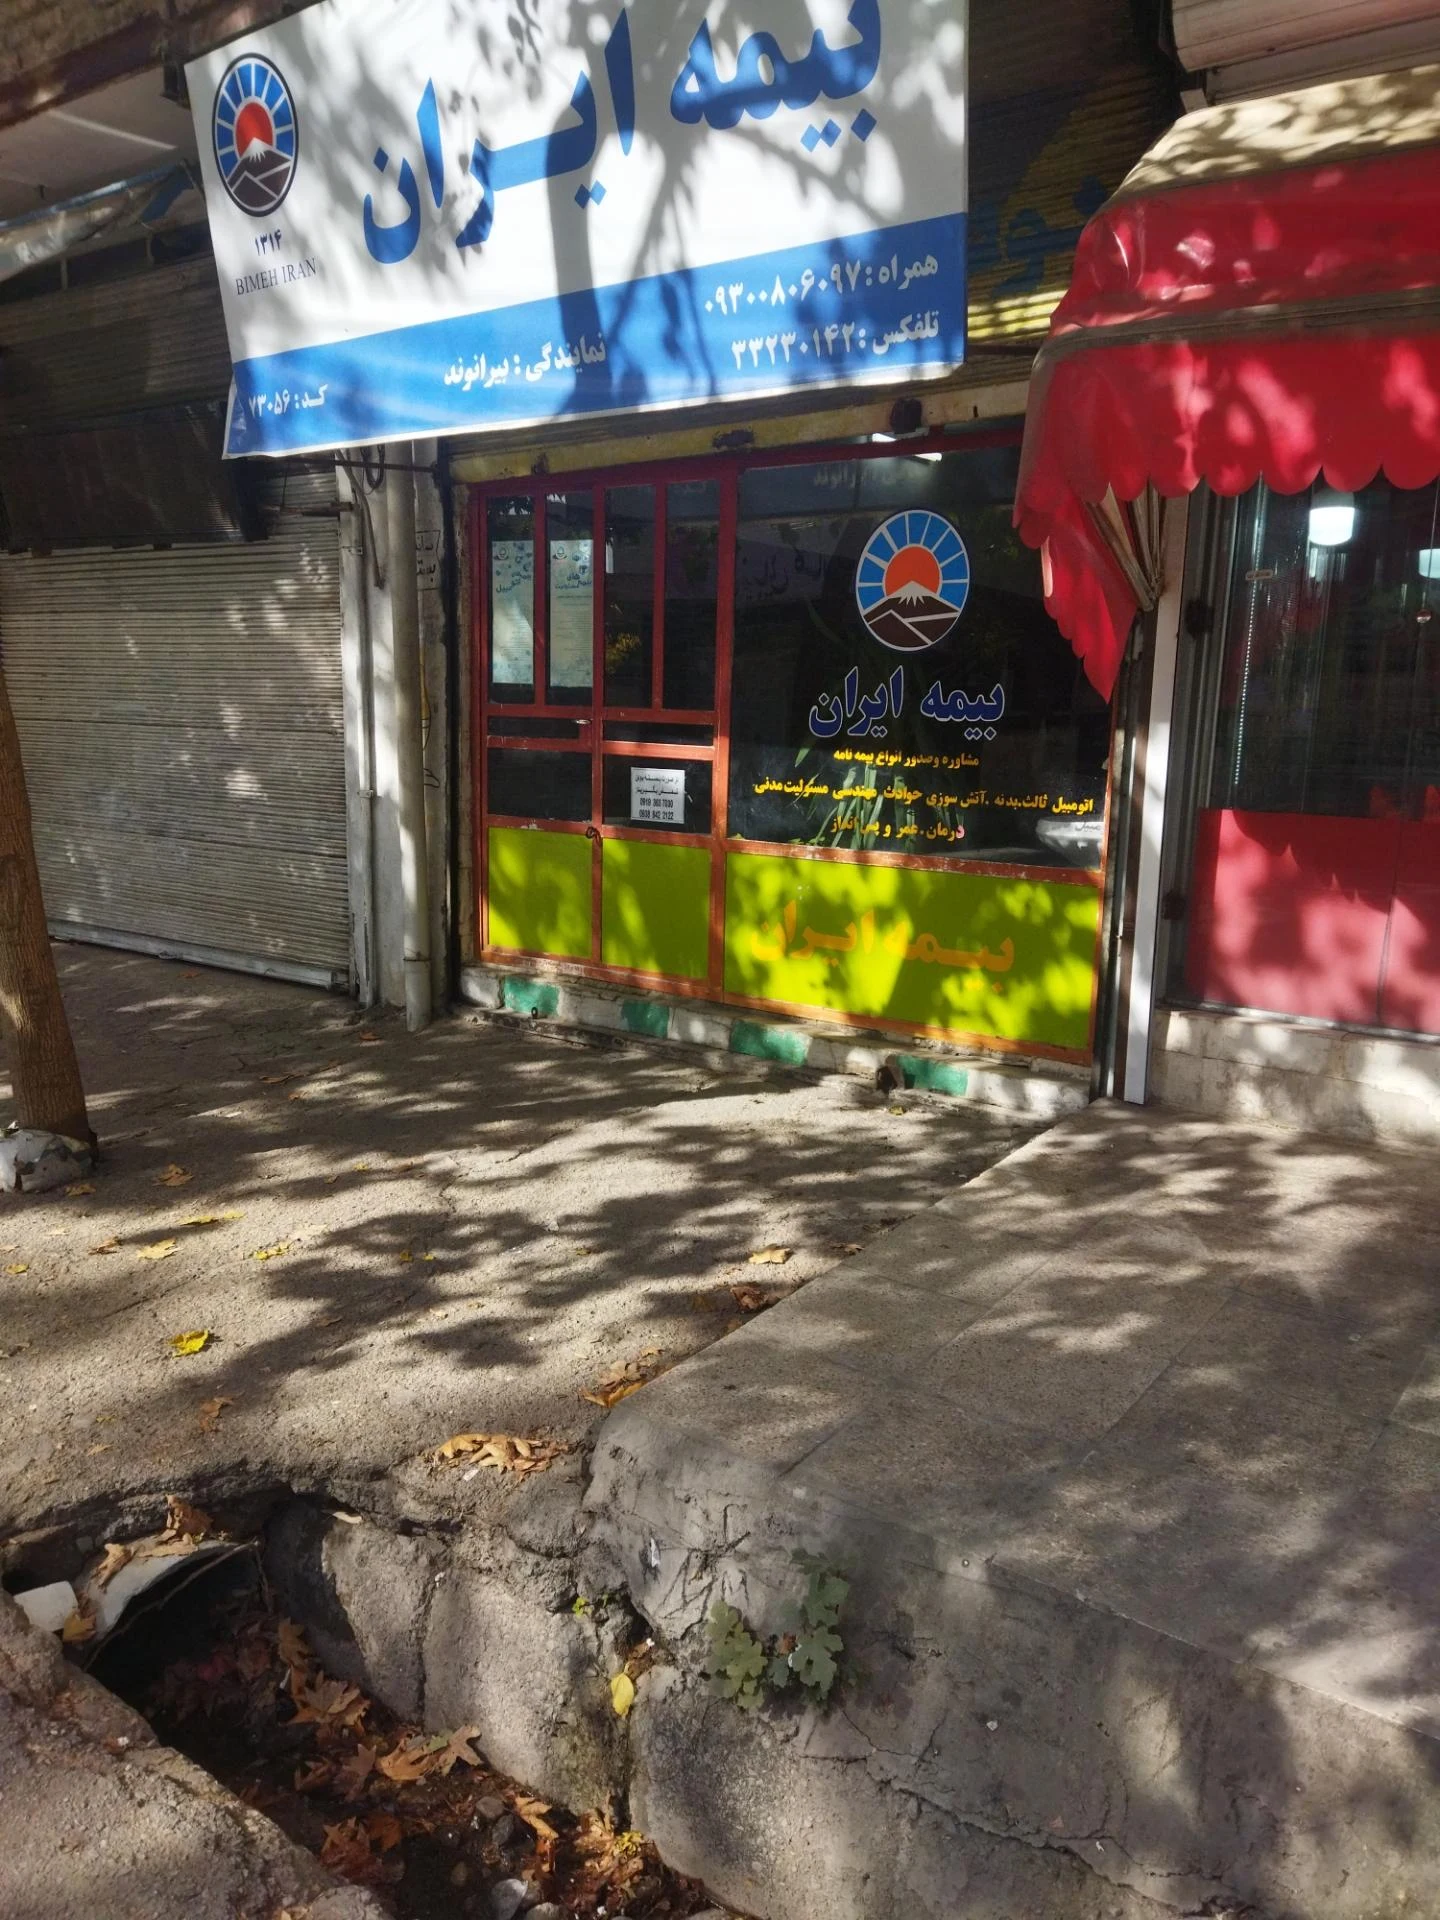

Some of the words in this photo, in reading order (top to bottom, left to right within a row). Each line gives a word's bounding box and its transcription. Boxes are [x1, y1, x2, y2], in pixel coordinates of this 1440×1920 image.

[670, 0, 881, 153] بیمه
[363, 8, 636, 265] ایران
[254, 228, 282, 256] ۱۳۱۴
[235, 268, 279, 295] BIMEH
[281, 258, 317, 283] IRAN
[704, 259, 861, 316] ۰۹۳۰۰۸۰۶۰۹۷
[731, 321, 856, 371] ۳۳۲۳۰۱۴۲
[443, 352, 509, 391] بیرانوند
[248, 388, 290, 418] ۷۳۰۵۶
[808, 665, 905, 738] ایران
[920, 680, 1005, 741] بیمه
[833, 748, 853, 760] نامه
[854, 750, 875, 764] بیمه
[875, 750, 902, 767] انواع
[942, 753, 980, 769] مشاوره
[754, 777, 783, 794] مدنی
[832, 785, 878, 800] مهندسی
[883, 785, 923, 805] حوادث
[926, 790, 958, 808] سوزی
[1052, 796, 1094, 815] اتومبیل
[883, 823, 892, 837] و
[751, 900, 875, 968] ایران
[883, 918, 1015, 994] بیمه
